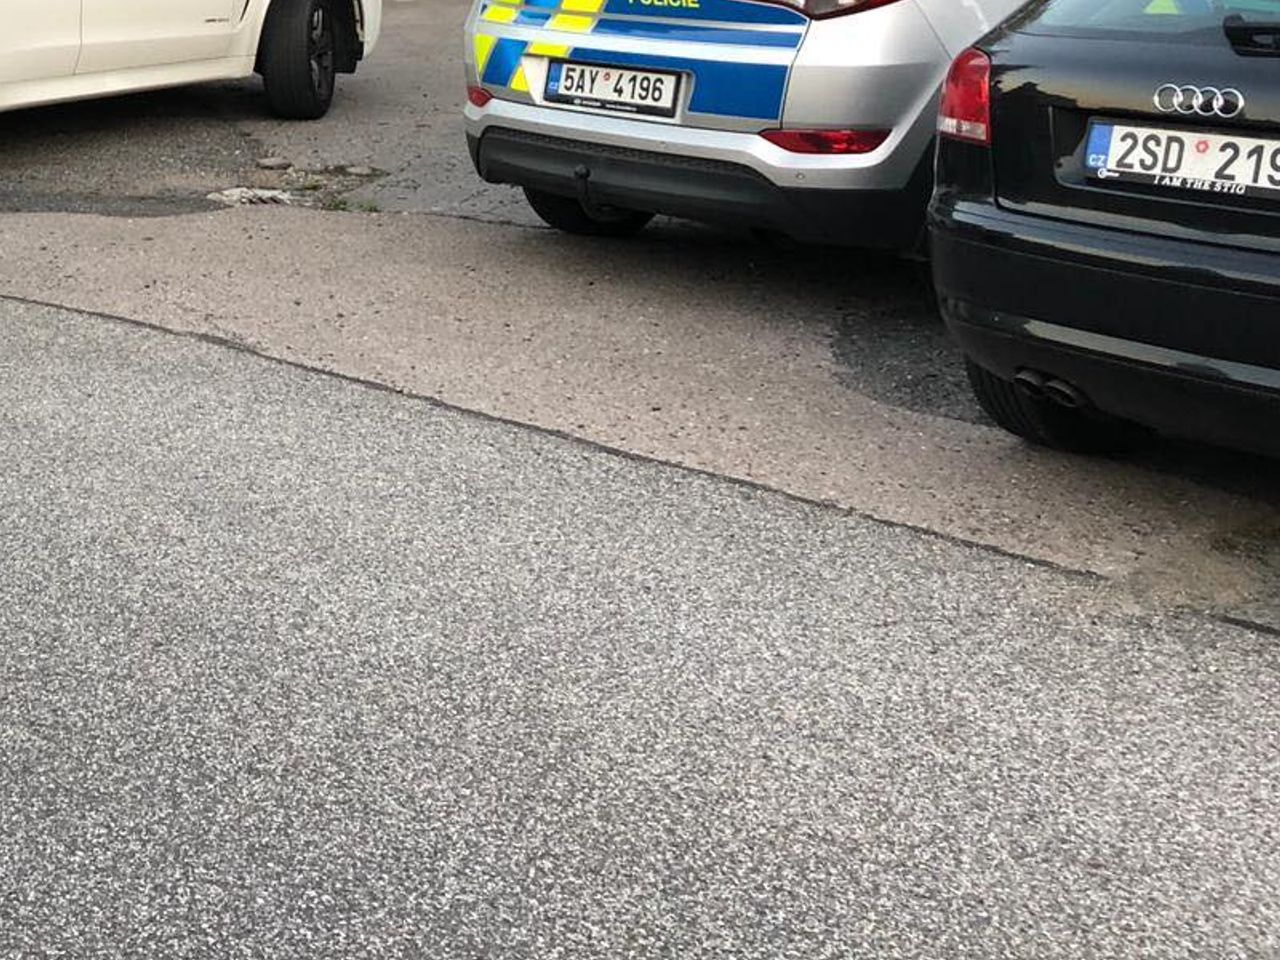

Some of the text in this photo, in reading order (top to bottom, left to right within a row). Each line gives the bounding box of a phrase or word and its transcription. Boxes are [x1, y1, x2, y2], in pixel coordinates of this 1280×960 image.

[563, 67, 665, 102] 5AY 4196
[1089, 154, 1106, 167] CZ
[1115, 131, 1185, 174] 2SD
[1185, 179, 1211, 190] THE
